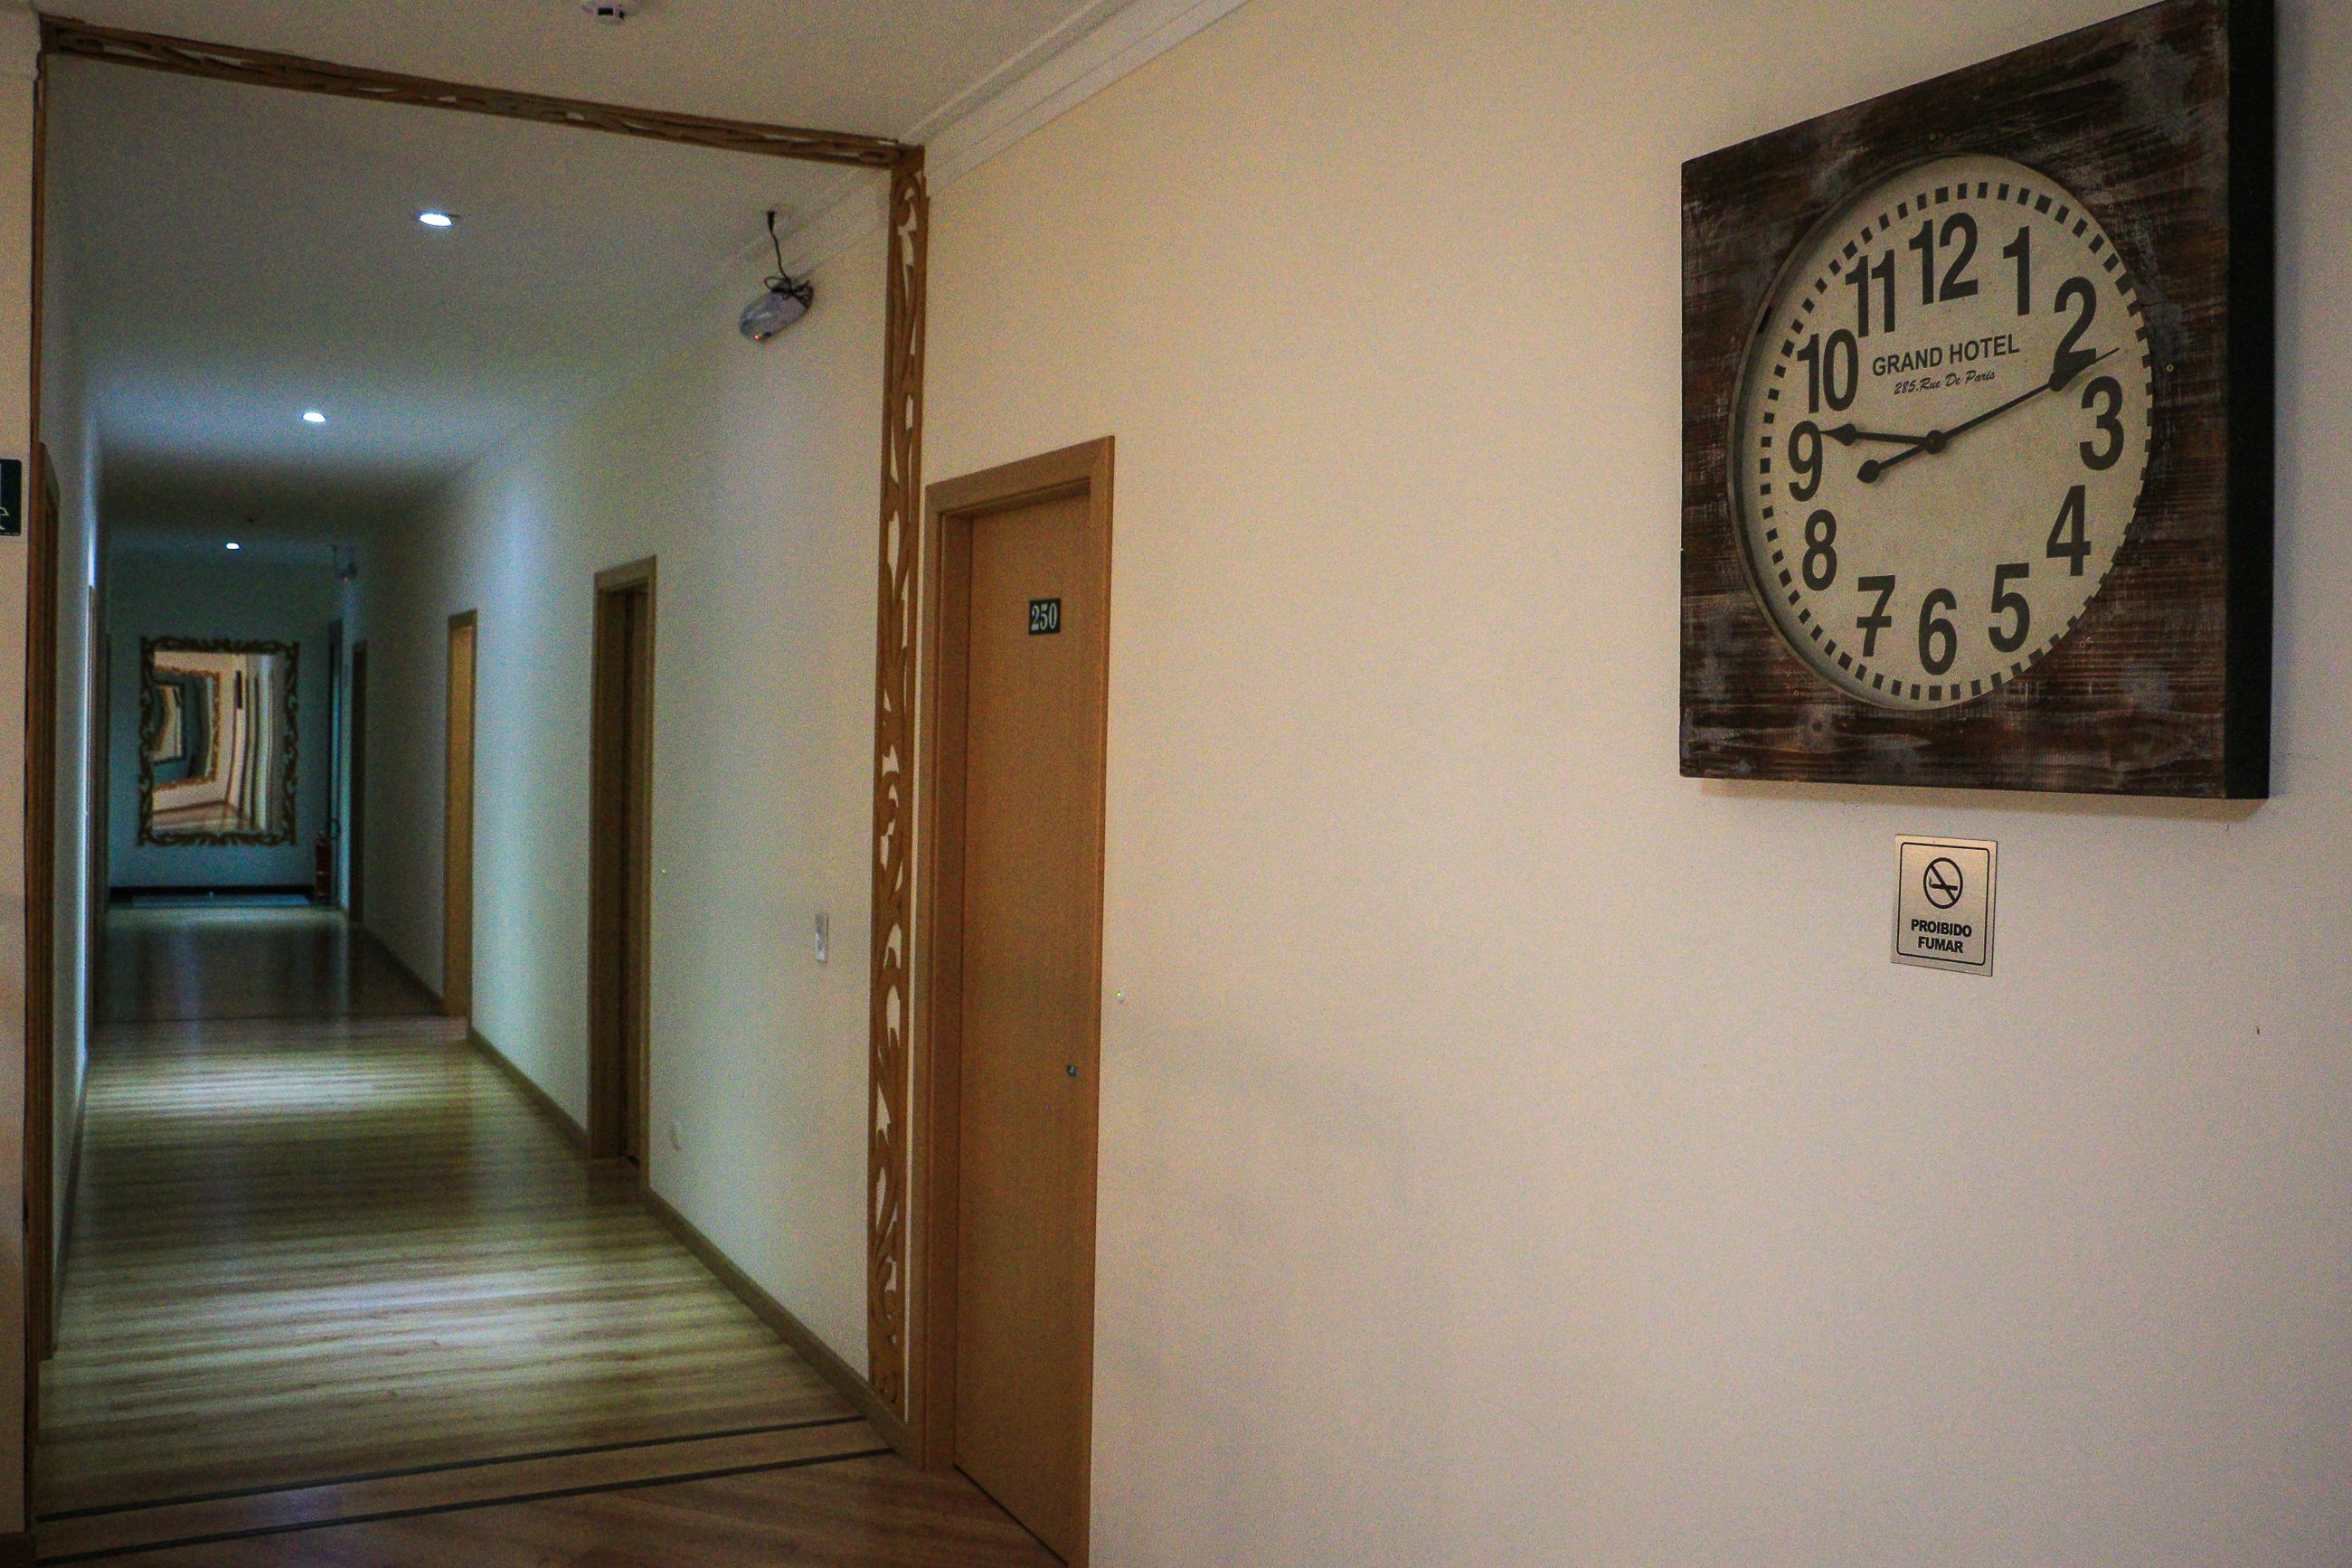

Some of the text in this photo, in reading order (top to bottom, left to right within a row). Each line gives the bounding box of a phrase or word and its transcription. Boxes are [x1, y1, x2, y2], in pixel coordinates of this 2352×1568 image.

[1846, 249, 1896, 338] 11
[1908, 212, 1979, 306] 12
[2003, 225, 2031, 316] 1
[1872, 334, 2020, 376] GRAND HOTEL
[2052, 276, 2098, 374] 2
[1797, 328, 1859, 413] 10
[1945, 372, 1961, 388] De
[1965, 368, 1997, 383] Paris
[1788, 420, 1824, 502] 9
[2080, 375, 2125, 471] 3
[1802, 509, 1837, 591] 8
[2046, 485, 2092, 577] 4
[1031, 603, 1058, 631] 250
[1856, 574, 1896, 657] 7
[1917, 588, 1959, 675] 6
[1988, 562, 2031, 653] 5
[1911, 919, 1972, 938] PROIBIDO
[1918, 936, 1964, 954] FUMAR
